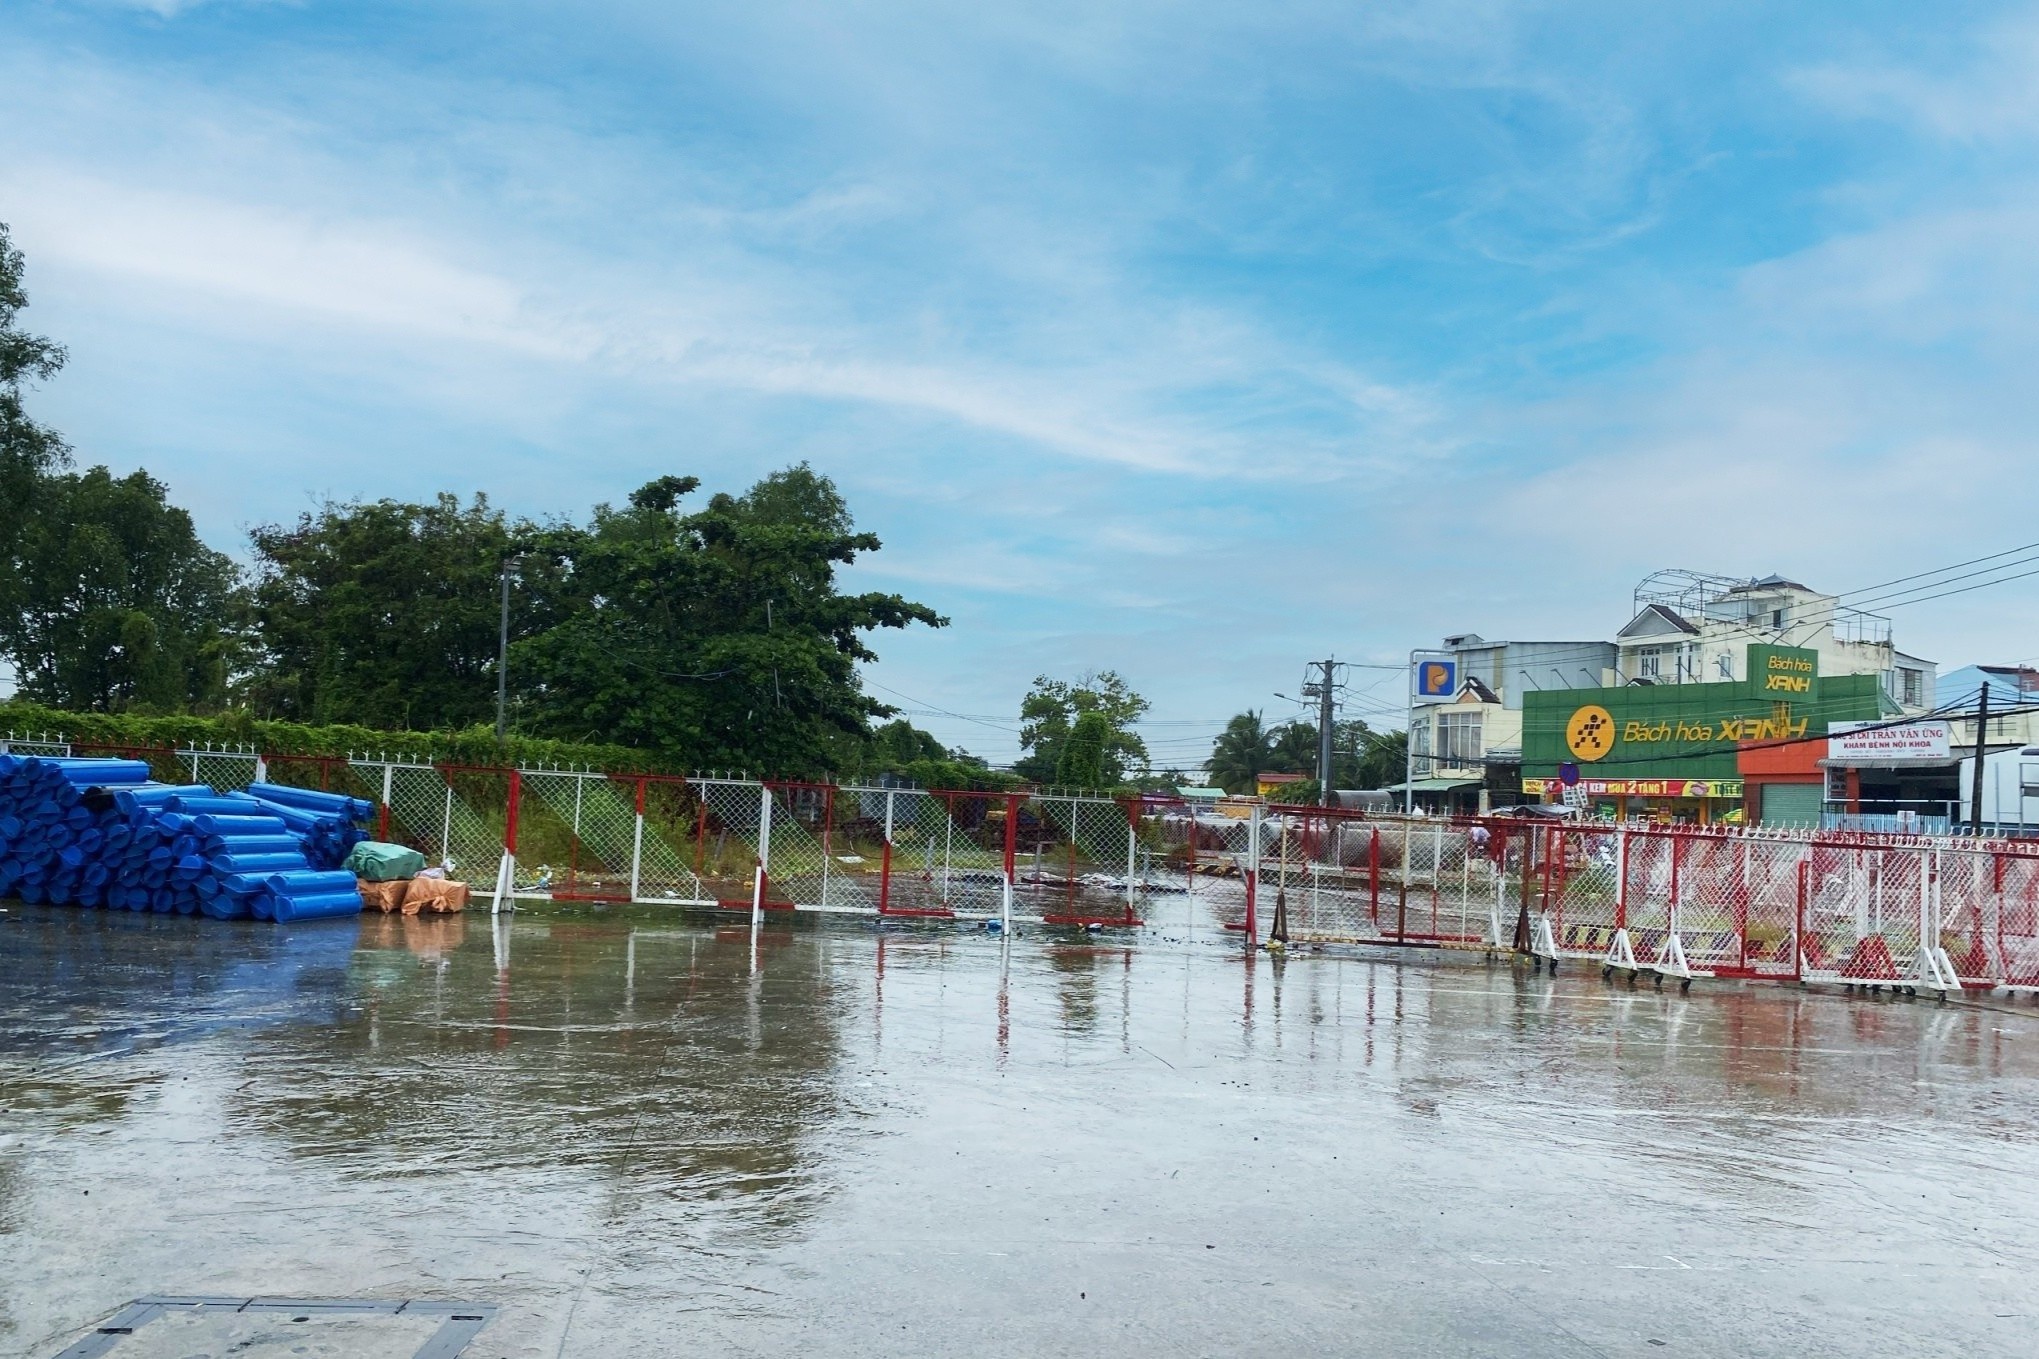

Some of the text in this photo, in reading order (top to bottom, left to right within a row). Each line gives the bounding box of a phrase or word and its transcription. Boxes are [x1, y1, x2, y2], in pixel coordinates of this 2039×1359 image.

[1768, 656, 1812, 672] Bách hóa
[1765, 674, 1811, 692] XANH
[1623, 718, 1808, 742] Bách hóa XANH
[1608, 783, 1626, 794] MUA
[1627, 780, 1637, 794] 2
[1661, 781, 1668, 794] 1
